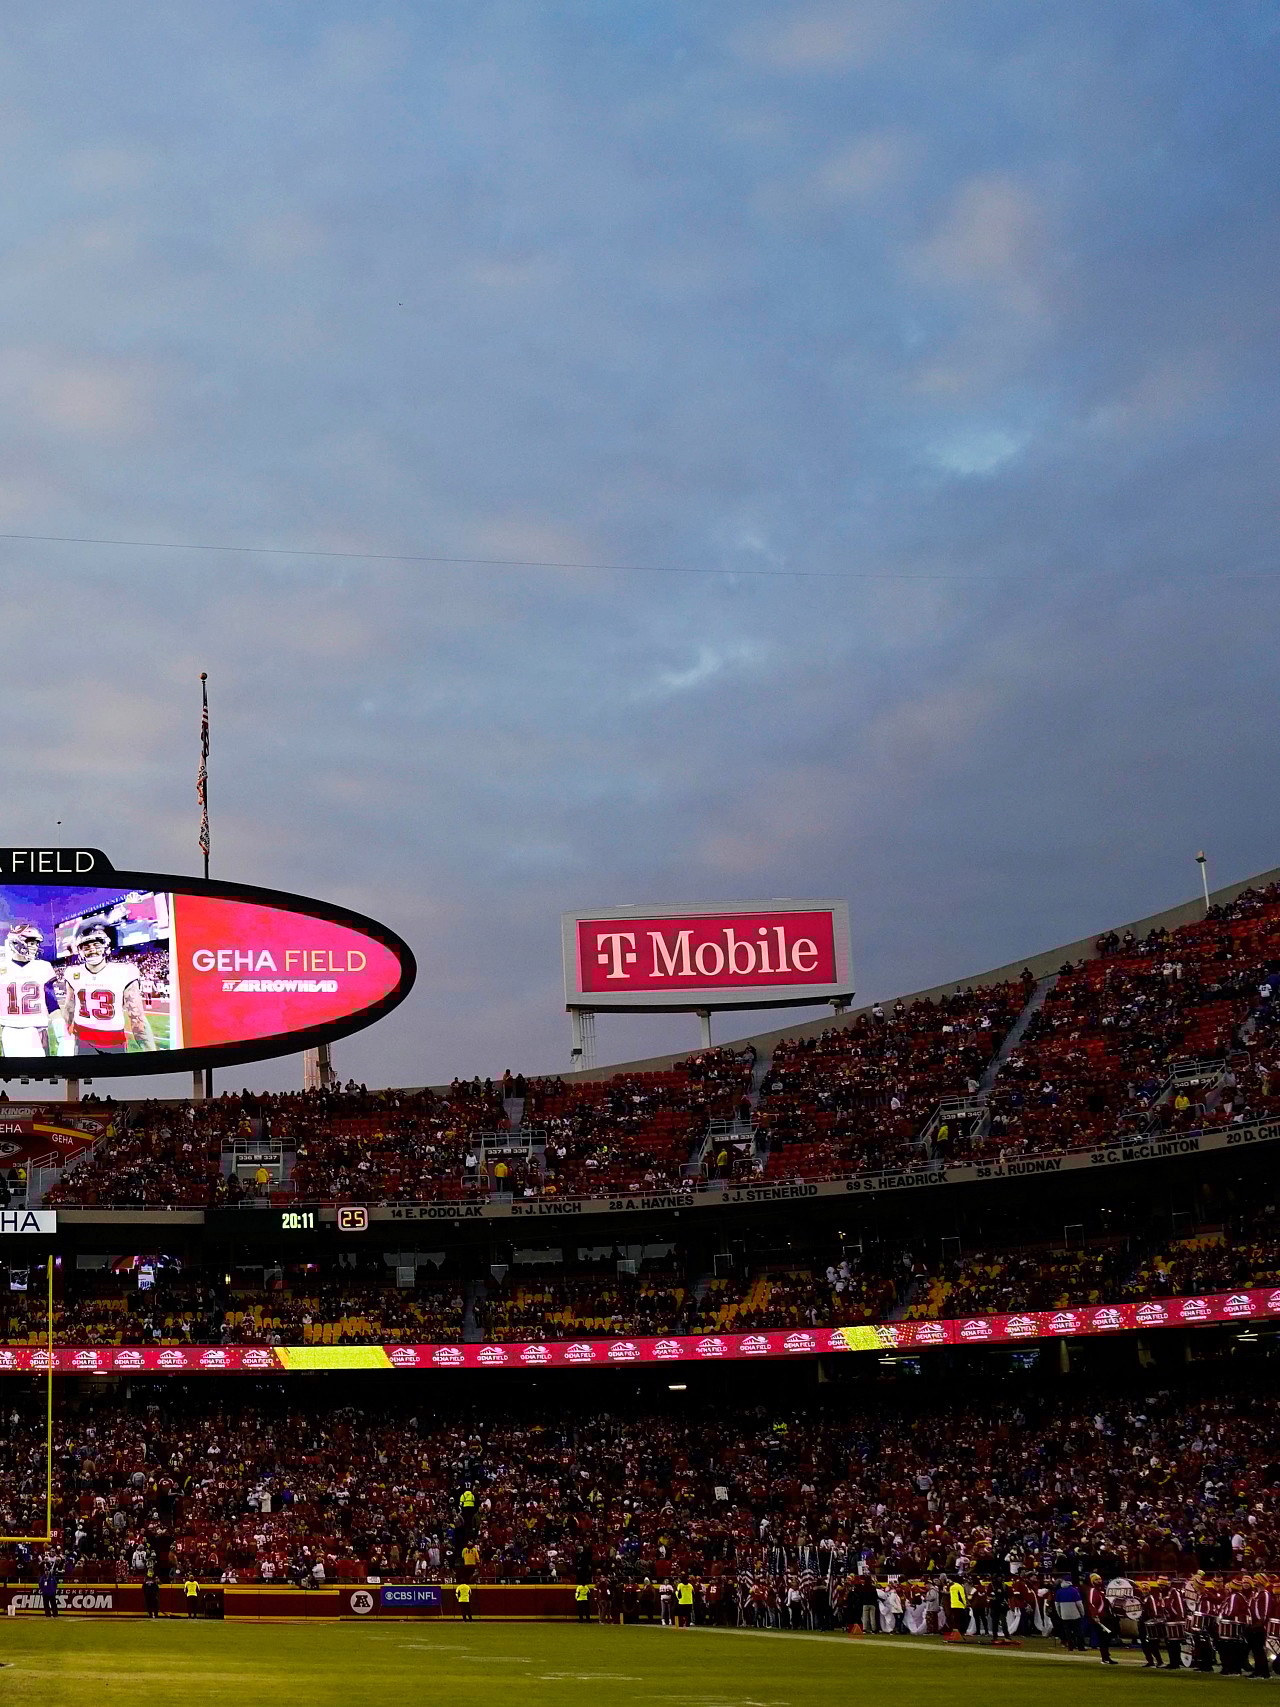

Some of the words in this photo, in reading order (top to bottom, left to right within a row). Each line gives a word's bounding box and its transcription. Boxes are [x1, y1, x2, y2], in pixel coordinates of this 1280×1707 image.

[12, 852, 95, 872] FIELD
[597, 932, 636, 978] T
[646, 926, 818, 976] Mobile
[192, 950, 278, 972] GEHA
[286, 950, 367, 972] FIELD
[222, 980, 235, 992] AT
[234, 980, 338, 992] ARROWHEAD
[6, 981, 42, 1014] 12
[78, 990, 116, 1020] 13
[52, 1134, 74, 1146] GEHA
[1227, 1133, 1241, 1144] 20
[1244, 1131, 1256, 1142] D.
[1091, 1154, 1105, 1164] 32
[1107, 1152, 1120, 1162] C.
[1122, 1139, 1199, 1160] McCLINTON
[976, 1168, 991, 1178] 58
[994, 1166, 1006, 1176] J.
[1008, 1158, 1062, 1174] RUDNAY
[846, 1182, 861, 1191] 69
[864, 1180, 876, 1190] S.
[878, 1172, 948, 1188] HEADRICK
[722, 1193, 729, 1202] 3
[732, 1192, 744, 1202] J.
[746, 1185, 818, 1200] STENERUD
[512, 1206, 523, 1214] 51
[526, 1204, 536, 1214] J.
[538, 1202, 582, 1214] LYNCH
[609, 1201, 623, 1210] 28
[626, 1200, 638, 1210] A.
[641, 1196, 694, 1209] HAYNES
[342, 1211, 364, 1227] 25
[392, 1209, 402, 1218] 14
[406, 1208, 417, 1218] E.
[420, 1206, 482, 1218] PODOLAK
[282, 1213, 314, 1228] 20:11
[394, 1591, 412, 1600] CBS
[418, 1591, 436, 1600] NFL
